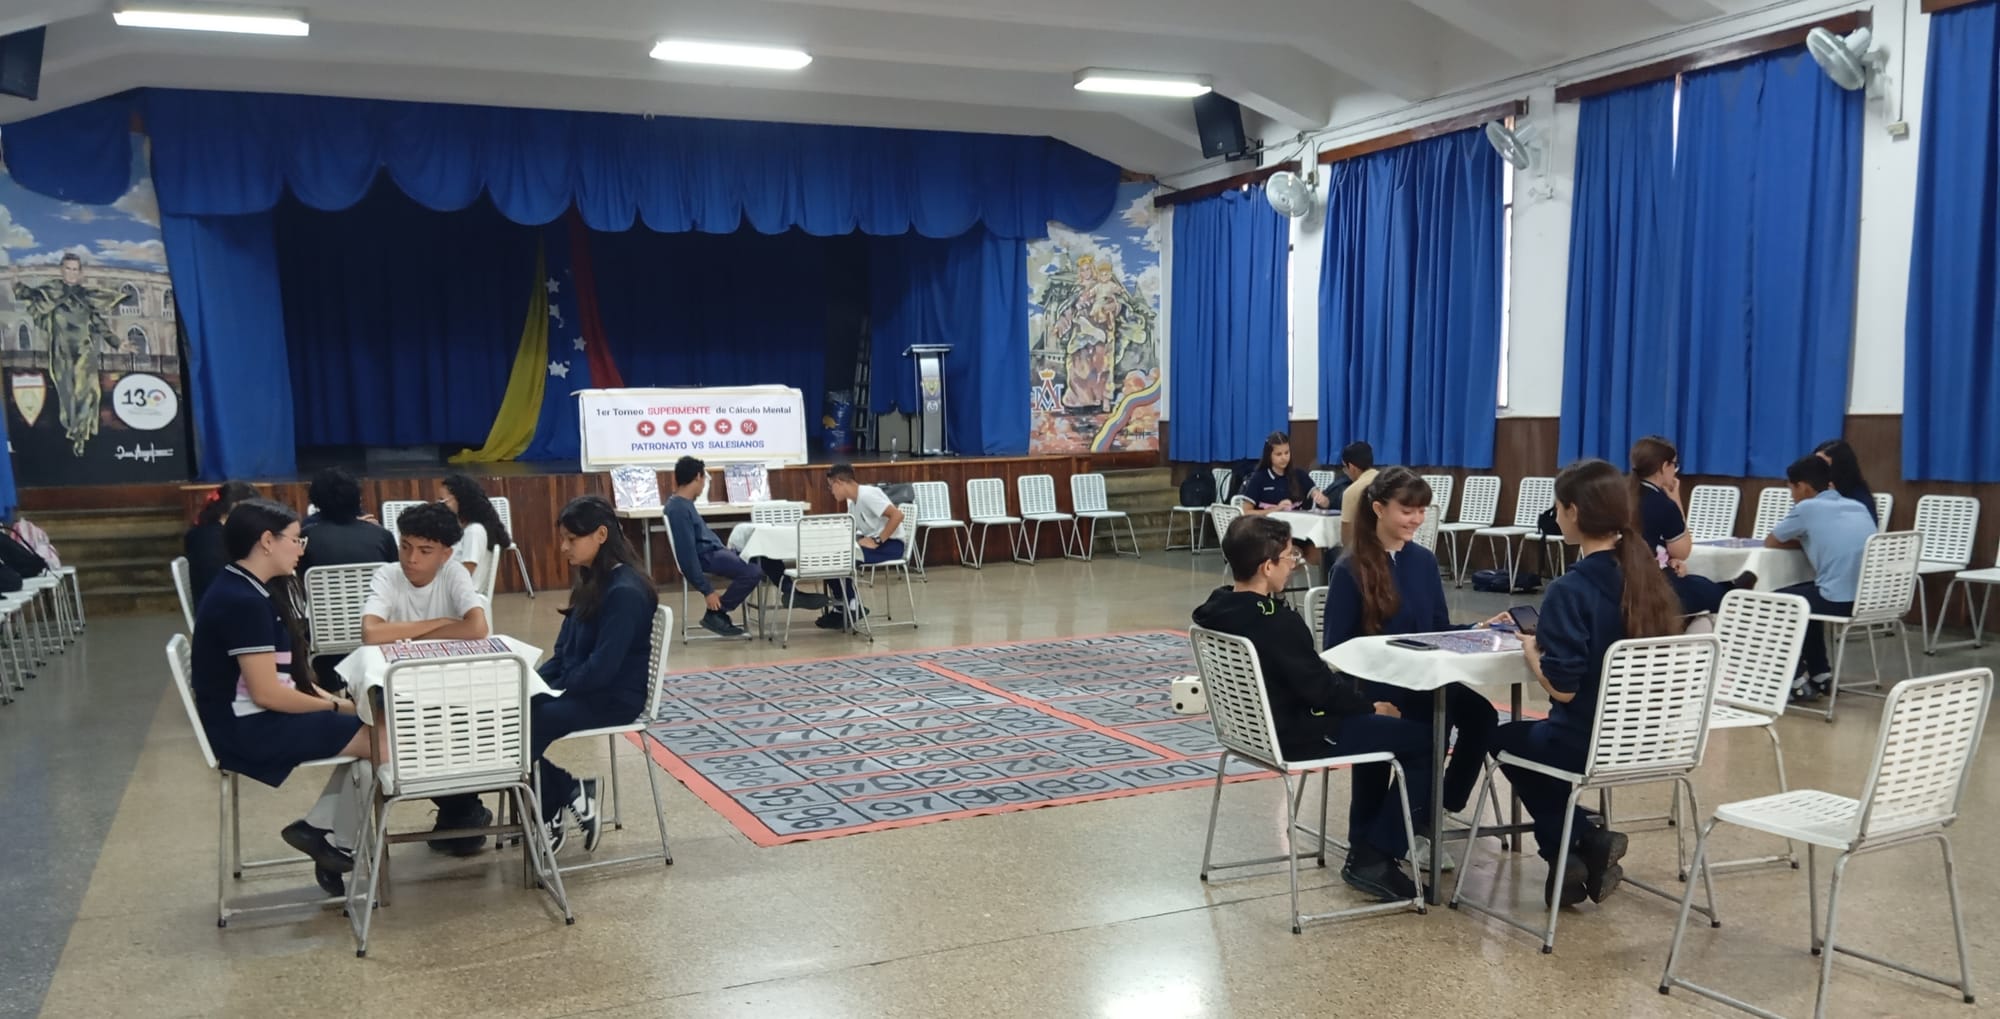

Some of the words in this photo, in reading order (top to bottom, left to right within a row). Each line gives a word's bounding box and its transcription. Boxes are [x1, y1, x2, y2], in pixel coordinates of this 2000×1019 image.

[596, 408, 610, 417] 1er
[612, 407, 644, 417] Torneo
[647, 406, 711, 417] SUPERMENTE
[716, 406, 727, 415] de
[728, 404, 761, 415] Cálculo
[763, 405, 792, 415] Mental
[631, 441, 687, 452] PATRONATO
[691, 440, 705, 450] VS
[708, 439, 765, 450] SALESIANOS
[713, 702, 765, 715] 67
[779, 698, 840, 710] 68
[849, 690, 915, 702] 69
[874, 701, 939, 714] 72
[729, 716, 798, 729] 74
[802, 709, 870, 722] 73
[750, 728, 813, 744] 77
[824, 722, 894, 736] 78
[899, 713, 969, 727] 79
[922, 726, 1000, 742] 82
[680, 736, 738, 751] 76
[853, 735, 926, 751] 83
[1045, 734, 1110, 751] 90
[773, 744, 850, 761] 84
[804, 759, 865, 776] 87
[887, 749, 960, 766] 88
[954, 740, 1036, 757] 89
[1075, 747, 1147, 763] 91
[704, 754, 759, 770] 85
[994, 755, 1074, 773] 92
[723, 770, 780, 786] 86
[914, 765, 992, 785] 93
[826, 773, 912, 796] 94
[869, 796, 933, 816] 97
[950, 786, 1030, 804] 98
[1036, 774, 1109, 794] 99
[1121, 764, 1204, 781] 100
[747, 787, 814, 806] 95
[777, 806, 846, 829] 96
